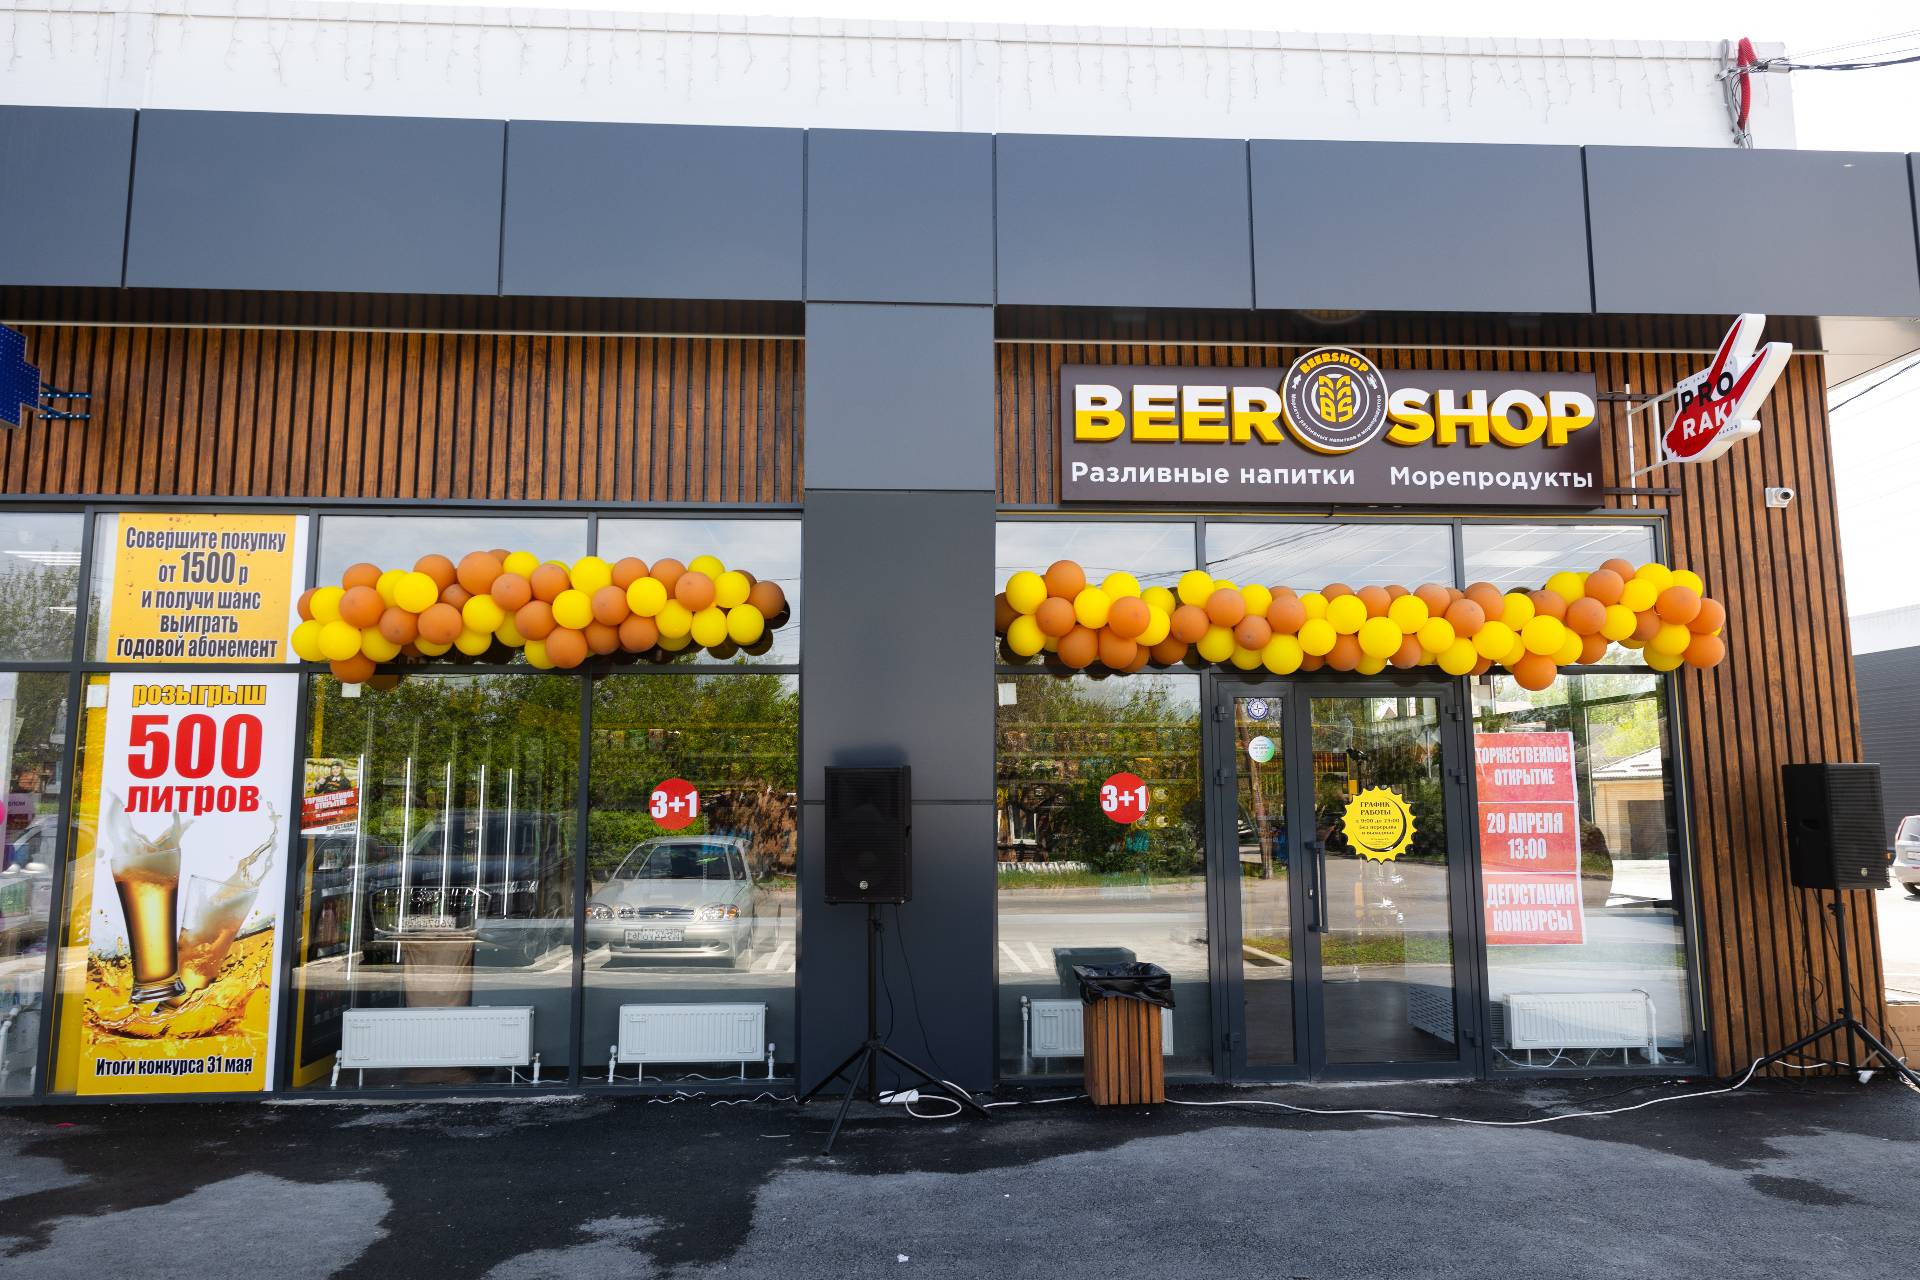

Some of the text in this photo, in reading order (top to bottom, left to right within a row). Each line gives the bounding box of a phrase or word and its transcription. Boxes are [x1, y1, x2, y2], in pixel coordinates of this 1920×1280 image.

[1299, 352, 1369, 375] BEERSHOP
[1680, 371, 1734, 413] PRO
[1075, 384, 1596, 446] BEER SHOP
[1071, 461, 1593, 490] Разливные напитки Морепродукты
[126, 527, 286, 552] Совершите покупку
[158, 551, 248, 585] от 1500 р
[141, 591, 261, 611] и получи шанс
[160, 614, 239, 634] выиграть
[117, 634, 278, 658] годовой абонемент
[132, 684, 267, 708] розыгрыш
[127, 713, 262, 779] 500
[1475, 746, 1569, 764] ТОРЖЕСТВЕННОЕ
[1494, 768, 1555, 785] ОТКРЫТИЕ
[124, 785, 260, 816] литров
[651, 790, 698, 819] 3+1
[1102, 784, 1146, 812] 3+1
[1487, 812, 1563, 834] 20 АПРЕЛЯ
[1508, 838, 1547, 859] 13:00
[1487, 883, 1575, 908] ДЕГУСТАЦИЯ
[1493, 910, 1574, 931] КОНКУРСЫ
[96, 1056, 253, 1076] Итоги конкурса 31 мая
